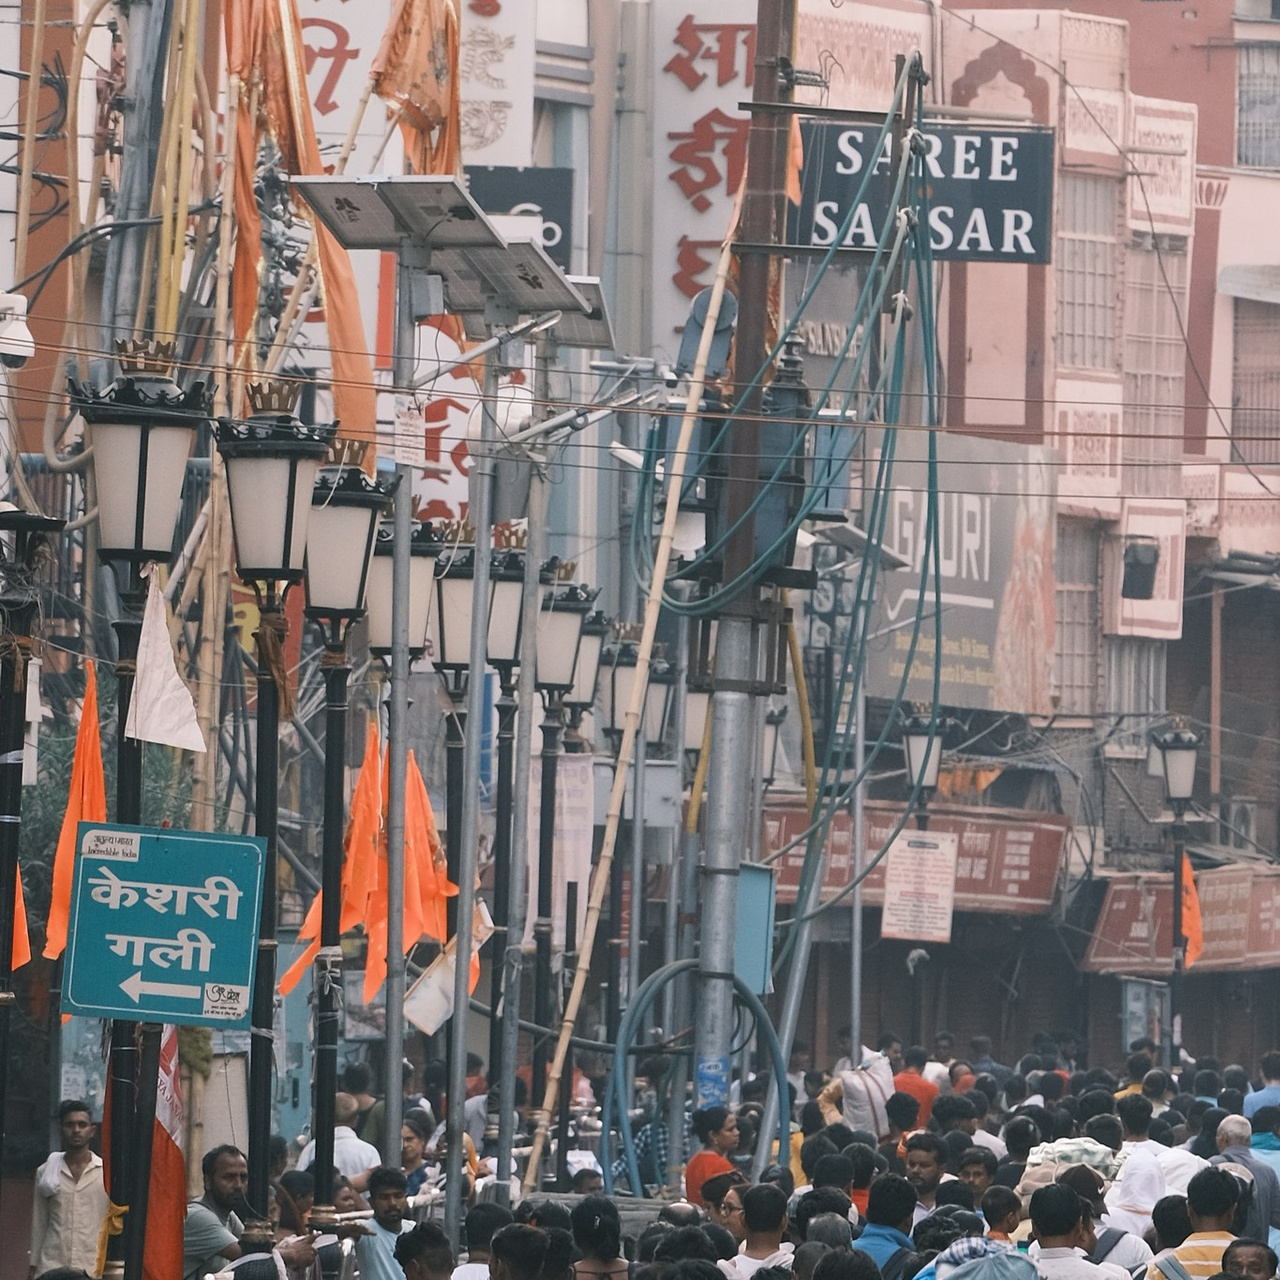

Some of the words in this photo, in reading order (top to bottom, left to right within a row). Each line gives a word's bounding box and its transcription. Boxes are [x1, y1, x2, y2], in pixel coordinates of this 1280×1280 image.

[811, 201, 1036, 254] SASAR
[87, 865, 244, 920] केशरी
[105, 927, 216, 972] गली
